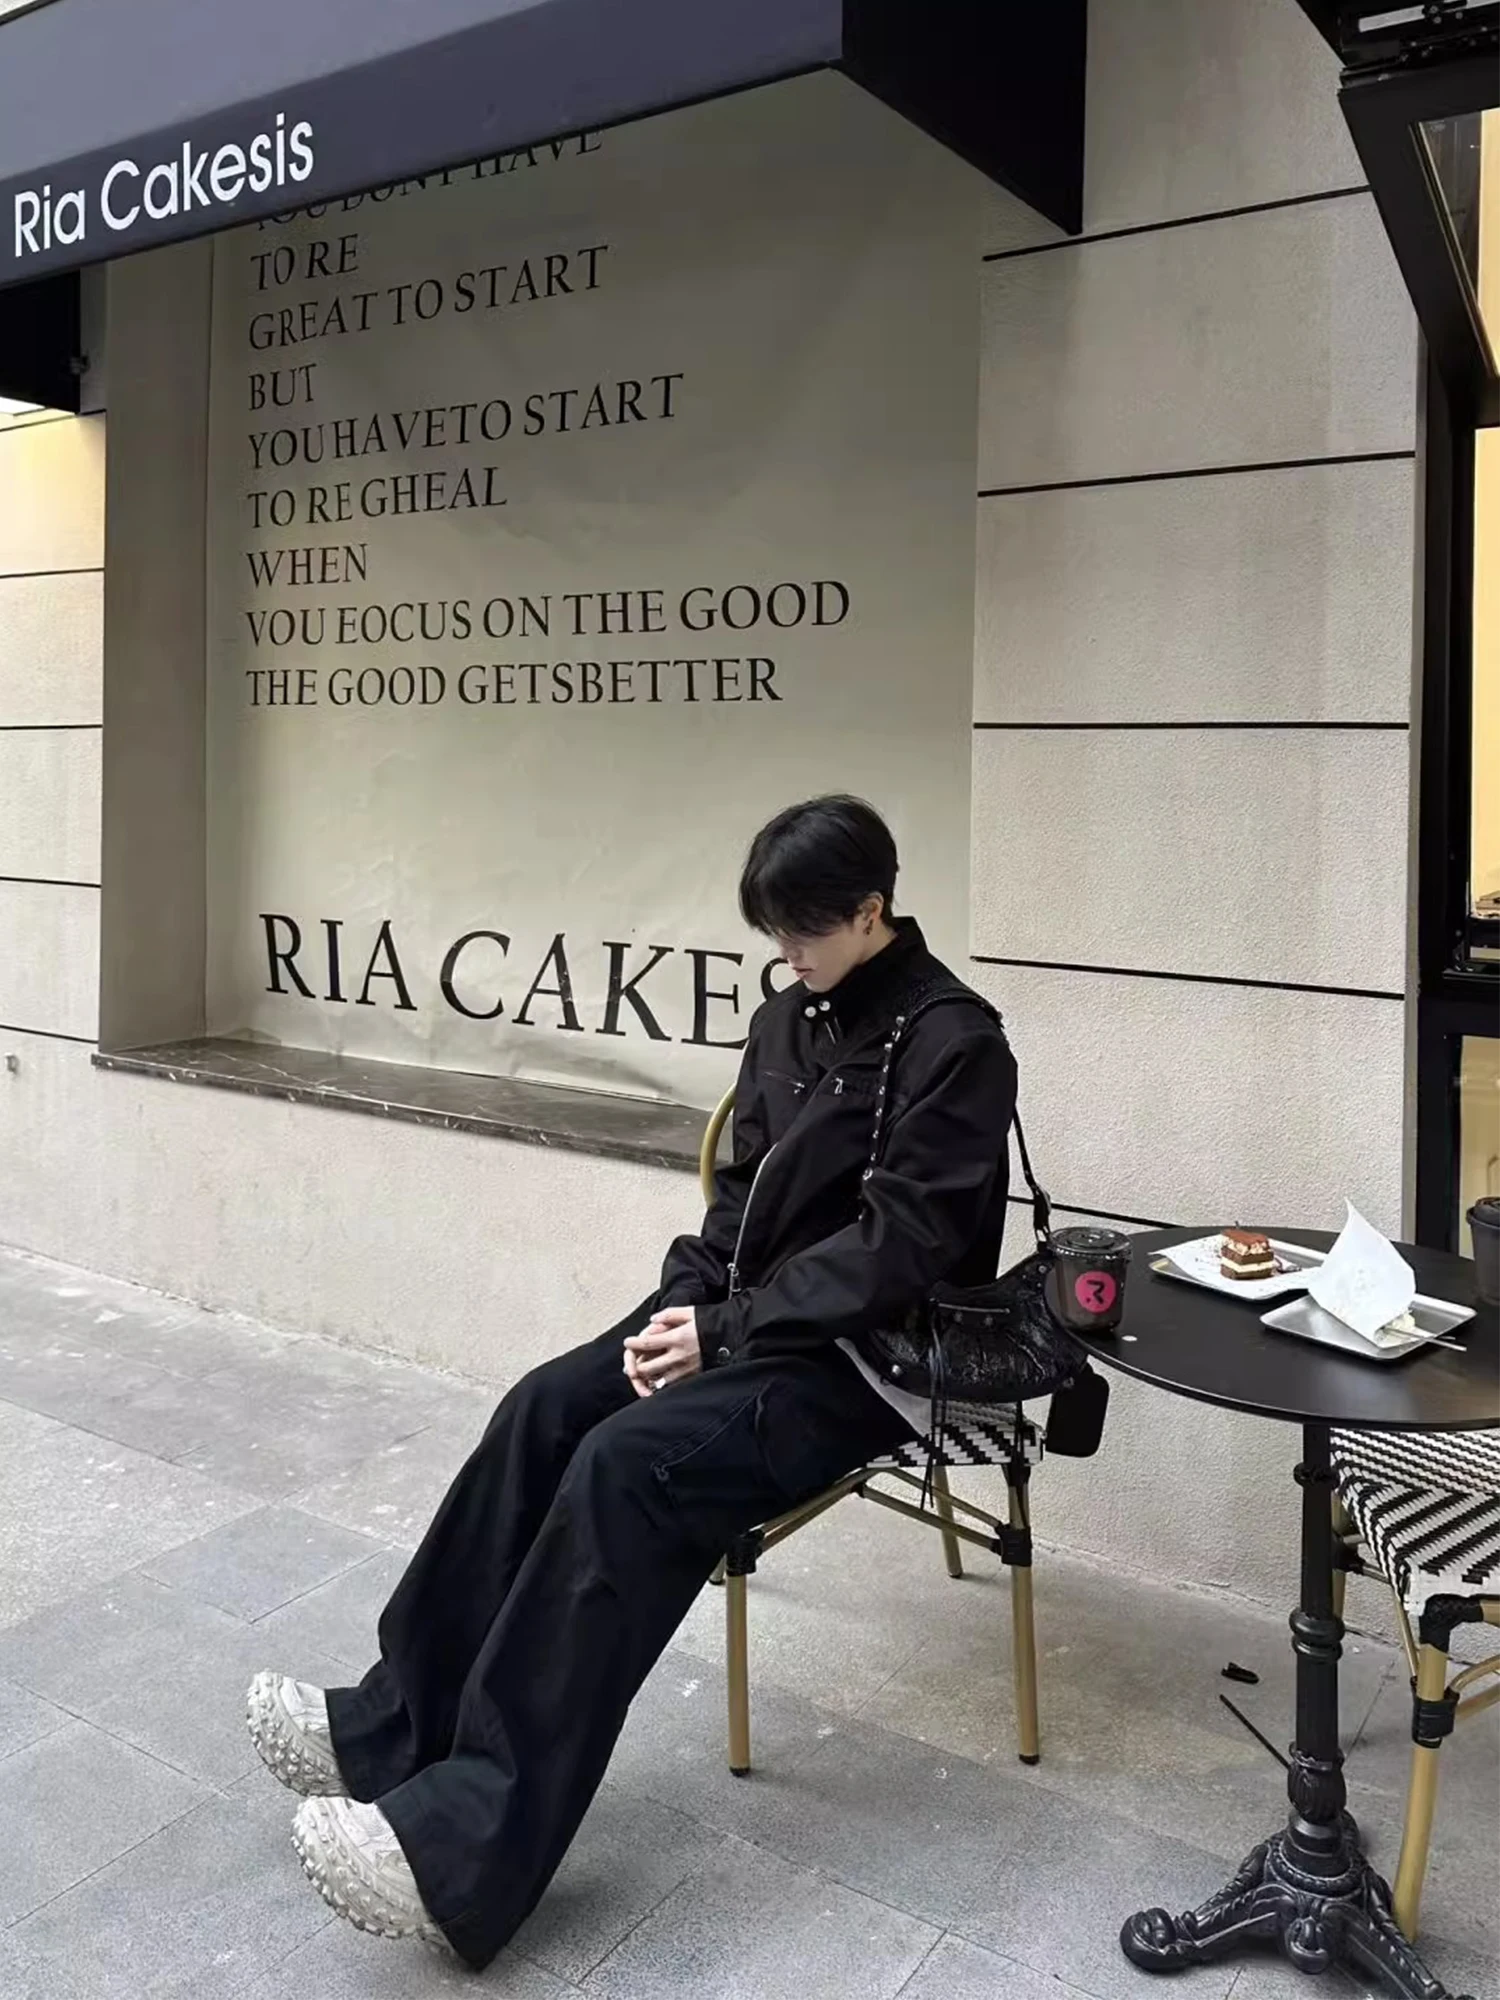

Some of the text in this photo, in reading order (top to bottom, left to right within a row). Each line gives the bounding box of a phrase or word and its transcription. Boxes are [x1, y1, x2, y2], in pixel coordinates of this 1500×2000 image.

[15, 185, 85, 257] Ria
[101, 112, 314, 230] Cakesis
[250, 246, 608, 350] GREAT TO START
[249, 363, 316, 412] BUT
[524, 373, 684, 438] START
[248, 489, 295, 528] TO
[247, 543, 368, 588] WHEN
[483, 596, 552, 638] ON
[563, 590, 668, 635] THE
[680, 580, 850, 631] GOOD
[246, 669, 318, 706] THE
[328, 667, 446, 705] GOOD
[259, 913, 417, 1011] RIA
